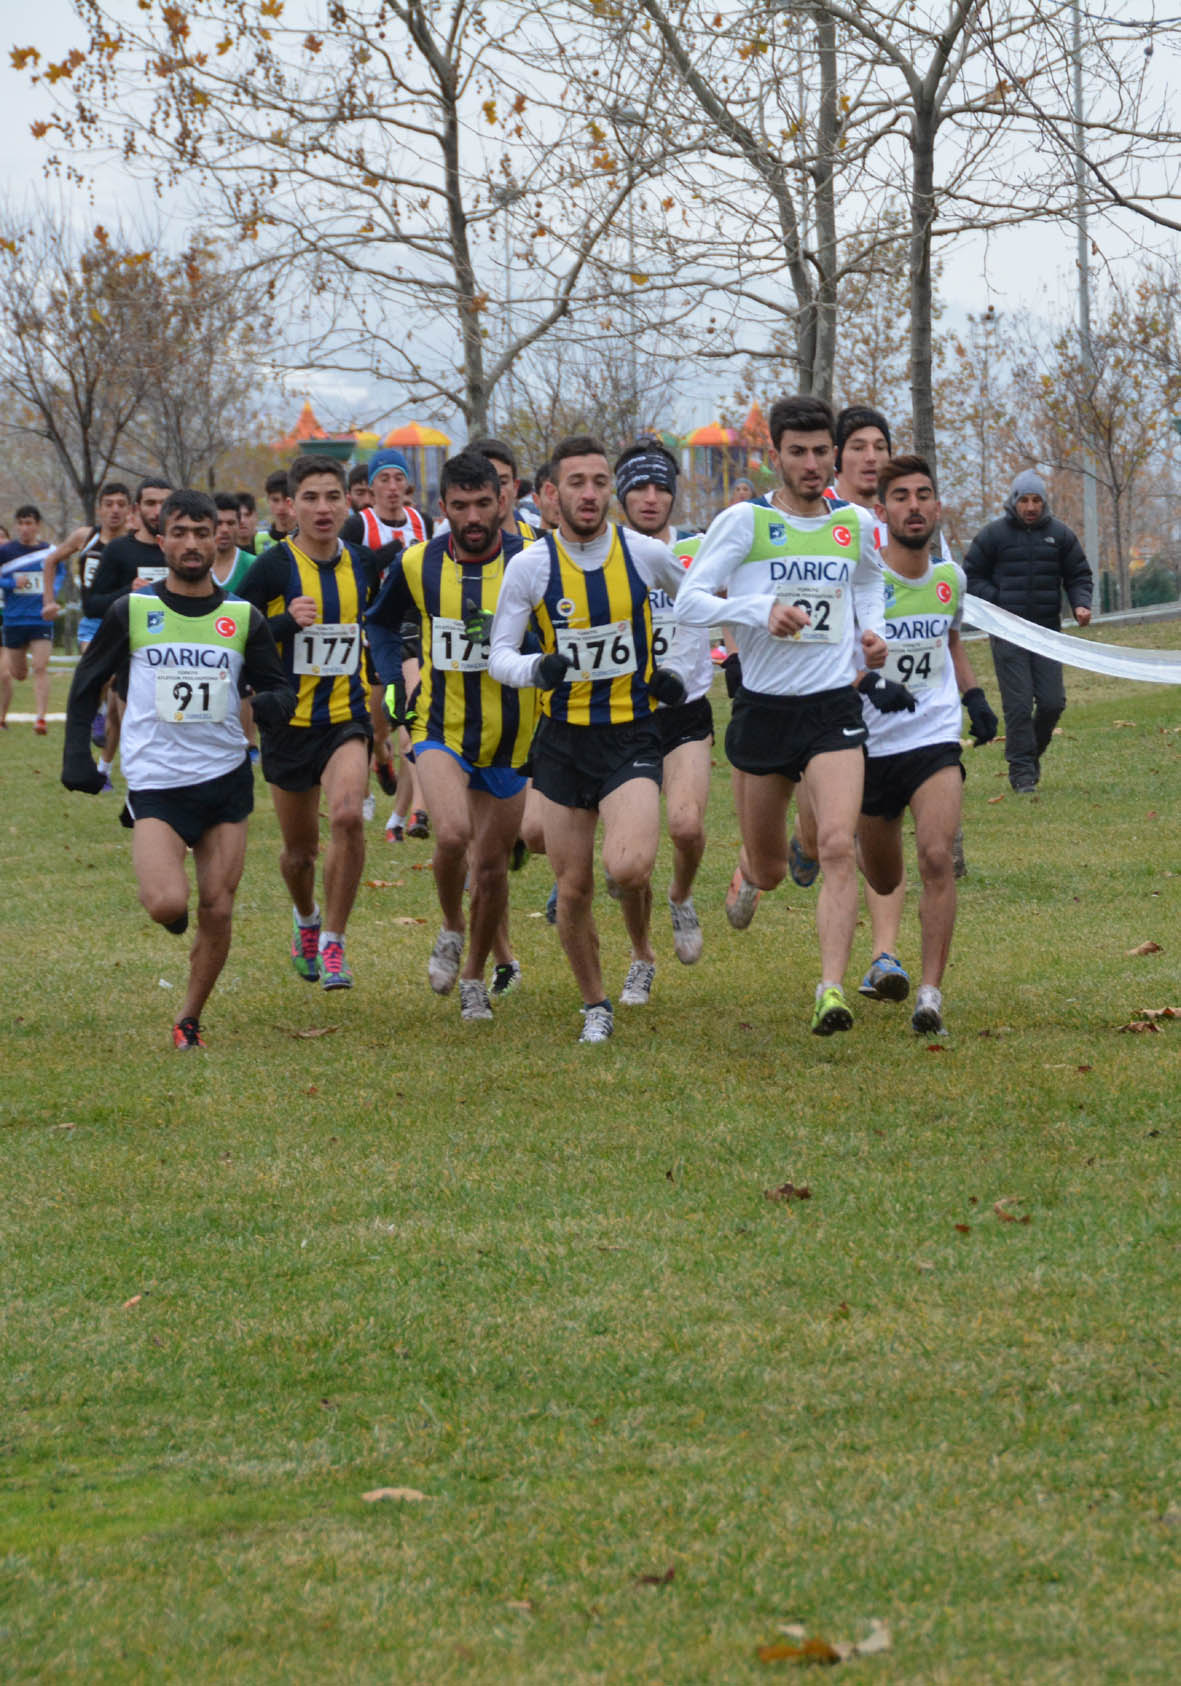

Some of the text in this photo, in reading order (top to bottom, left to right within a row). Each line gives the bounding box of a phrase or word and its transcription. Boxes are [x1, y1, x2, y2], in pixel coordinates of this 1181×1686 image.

[770, 561, 849, 582] DARICA
[885, 619, 948, 640] DARIC
[146, 647, 229, 669] DARICA
[303, 636, 355, 665] 177
[567, 634, 630, 671] 176
[897, 651, 931, 683] 94
[172, 681, 210, 711] 91
